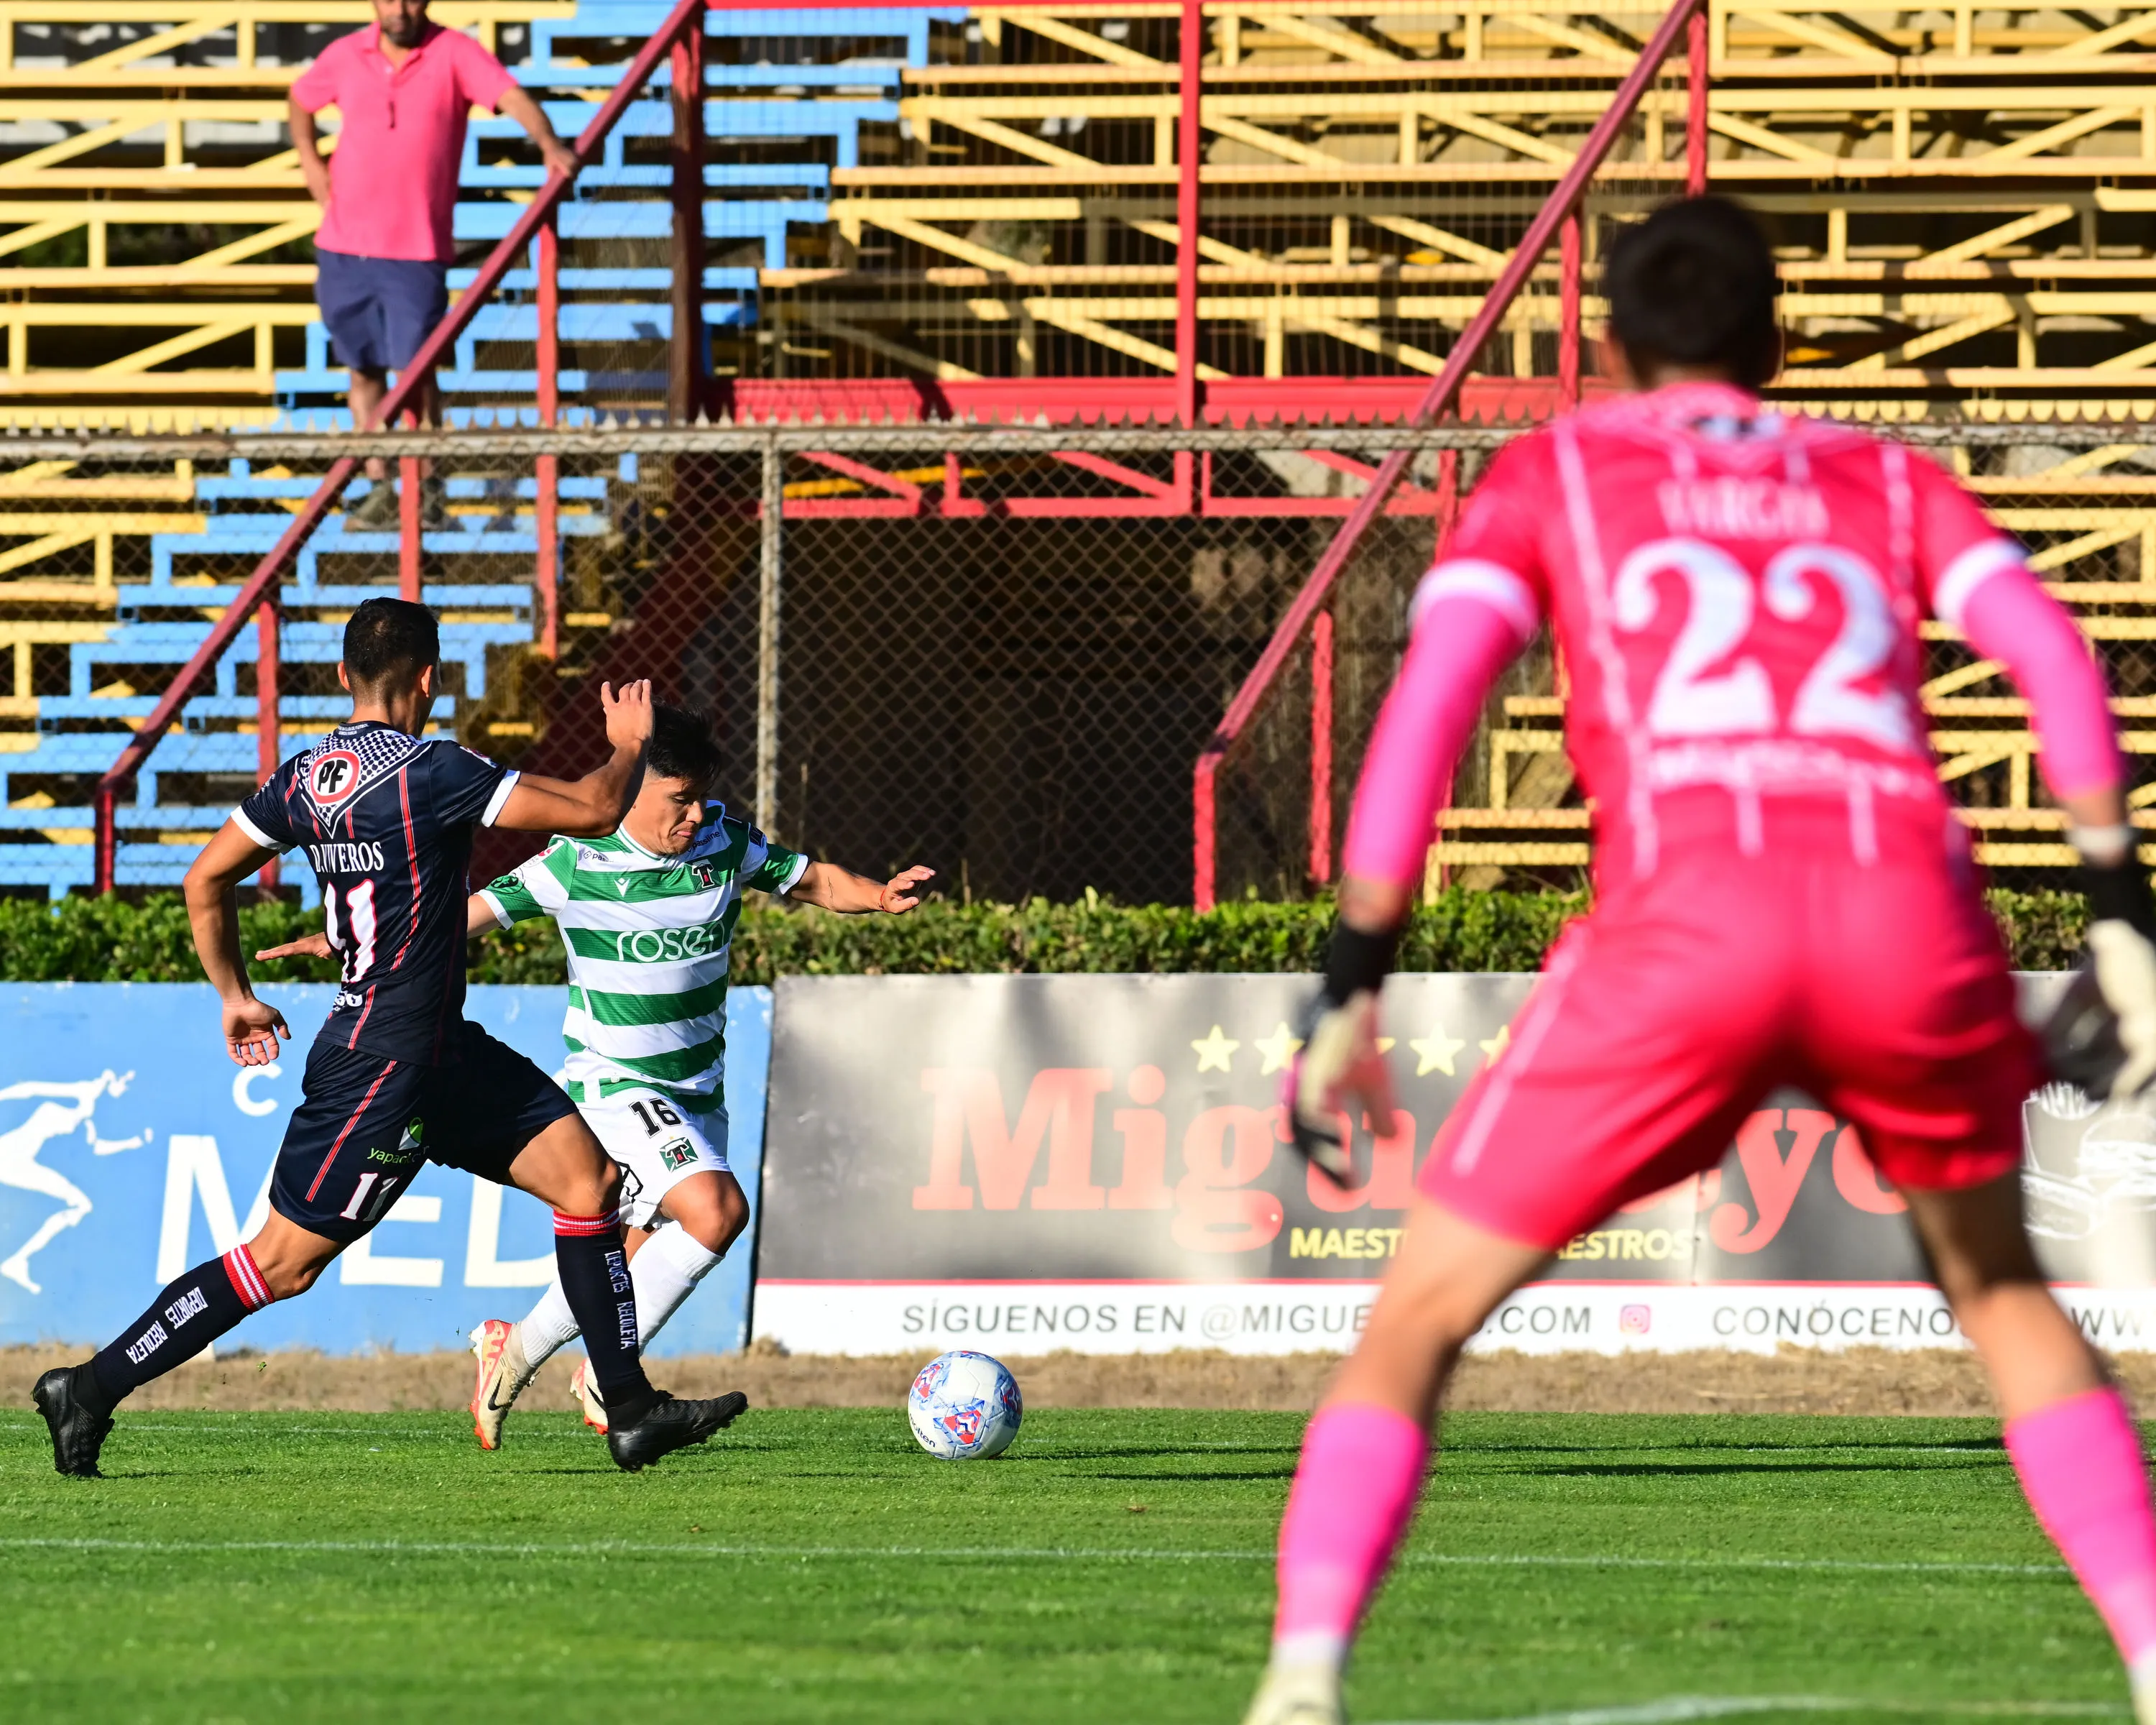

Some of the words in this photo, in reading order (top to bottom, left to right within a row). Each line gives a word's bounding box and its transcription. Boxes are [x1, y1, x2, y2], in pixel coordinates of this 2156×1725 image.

[1614, 536, 1910, 756] 22
[317, 760, 348, 794] PF
[691, 830, 721, 850] passline
[617, 920, 726, 962] rosen
[628, 1098, 683, 1138] 16
[340, 1172, 400, 1222] 11
[1290, 1227, 1407, 1259] MAEST
[1557, 1228, 1694, 1260] ESTROS
[165, 1287, 208, 1330] DEPORTES
[604, 1250, 630, 1293] DEPORTES
[617, 1301, 637, 1350] RECOLETA
[902, 1297, 1118, 1333] SÍGUENOS
[1134, 1305, 1186, 1333] EN
[1200, 1304, 1592, 1341] @MIGUE.COM
[125, 1320, 168, 1364] RECOLETA
